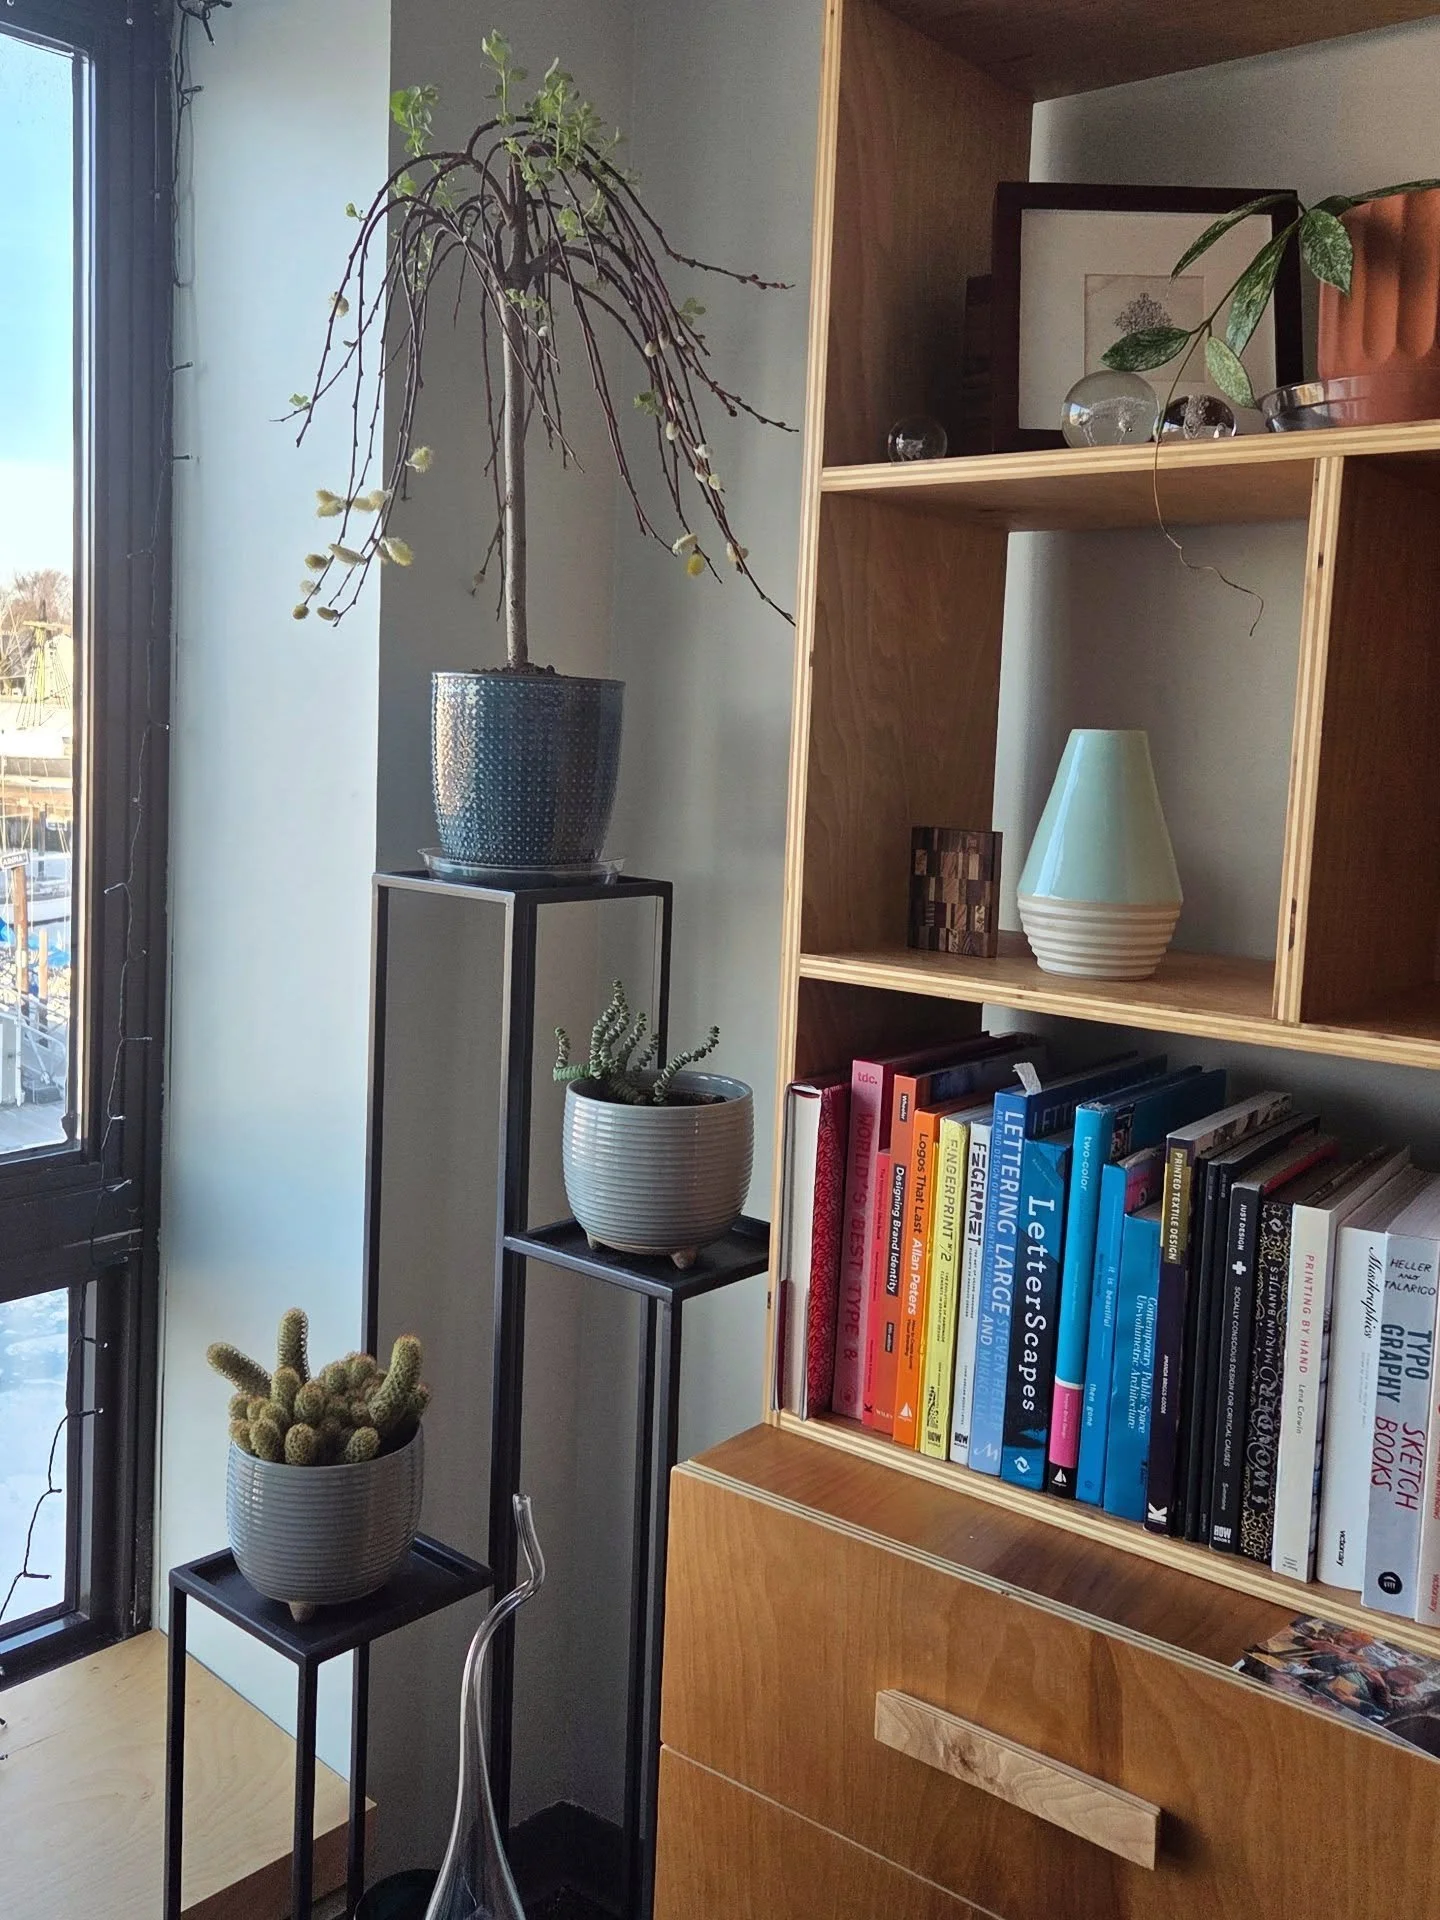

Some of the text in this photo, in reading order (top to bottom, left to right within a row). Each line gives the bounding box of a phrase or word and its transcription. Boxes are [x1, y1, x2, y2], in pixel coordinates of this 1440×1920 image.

[857, 1072, 878, 1085] tdc.
[900, 1095, 908, 1120] Wheeler
[942, 1139, 958, 1240] FINGERPRINT
[992, 1149, 1001, 1179] DESIGN
[1080, 1136, 1093, 1190] two-color
[887, 1167, 905, 1292] Designing Brand Identity
[908, 1134, 928, 1315] Logos That Last Allan Peters
[992, 1111, 1023, 1316] LETTERING LARGE
[1168, 1152, 1183, 1260] PRINTED TEXTILE DESIGN
[1237, 1204, 1247, 1251] JUST DESIGN
[843, 1113, 875, 1360] WORLD'S BEST TYPE &
[1384, 1280, 1436, 1296] TALARICO
[1390, 1259, 1432, 1272] HELLER
[1018, 1195, 1055, 1411] LetterScapes
[1103, 1290, 1113, 1327] beautiful
[1232, 1286, 1241, 1319] SOCIALLY
[1264, 1267, 1279, 1365] MARIAN BANTJES
[1360, 1247, 1383, 1339] Musikraphics
[981, 1314, 994, 1345] AND
[994, 1319, 1008, 1375] STEVEN
[1229, 1321, 1239, 1363] CONSCIOUS
[1296, 1255, 1315, 1434] PRINTING BY HAND Lena Corwin
[1405, 1330, 1432, 1380] TYPO
[1127, 1295, 1147, 1429] Un-volumetric Architecture
[1137, 1297, 1157, 1433] Contemporary Public Space
[1228, 1364, 1236, 1390] DESIGN
[1377, 1324, 1405, 1403] GRAPHY
[1086, 1383, 1097, 1426] then gone
[1224, 1408, 1233, 1438] CRITICAL
[1223, 1440, 1231, 1467] CAUSES
[1371, 1416, 1398, 1492] BOOKS
[1395, 1422, 1425, 1510] SKETCH
[1213, 1525, 1231, 1540] HOW
